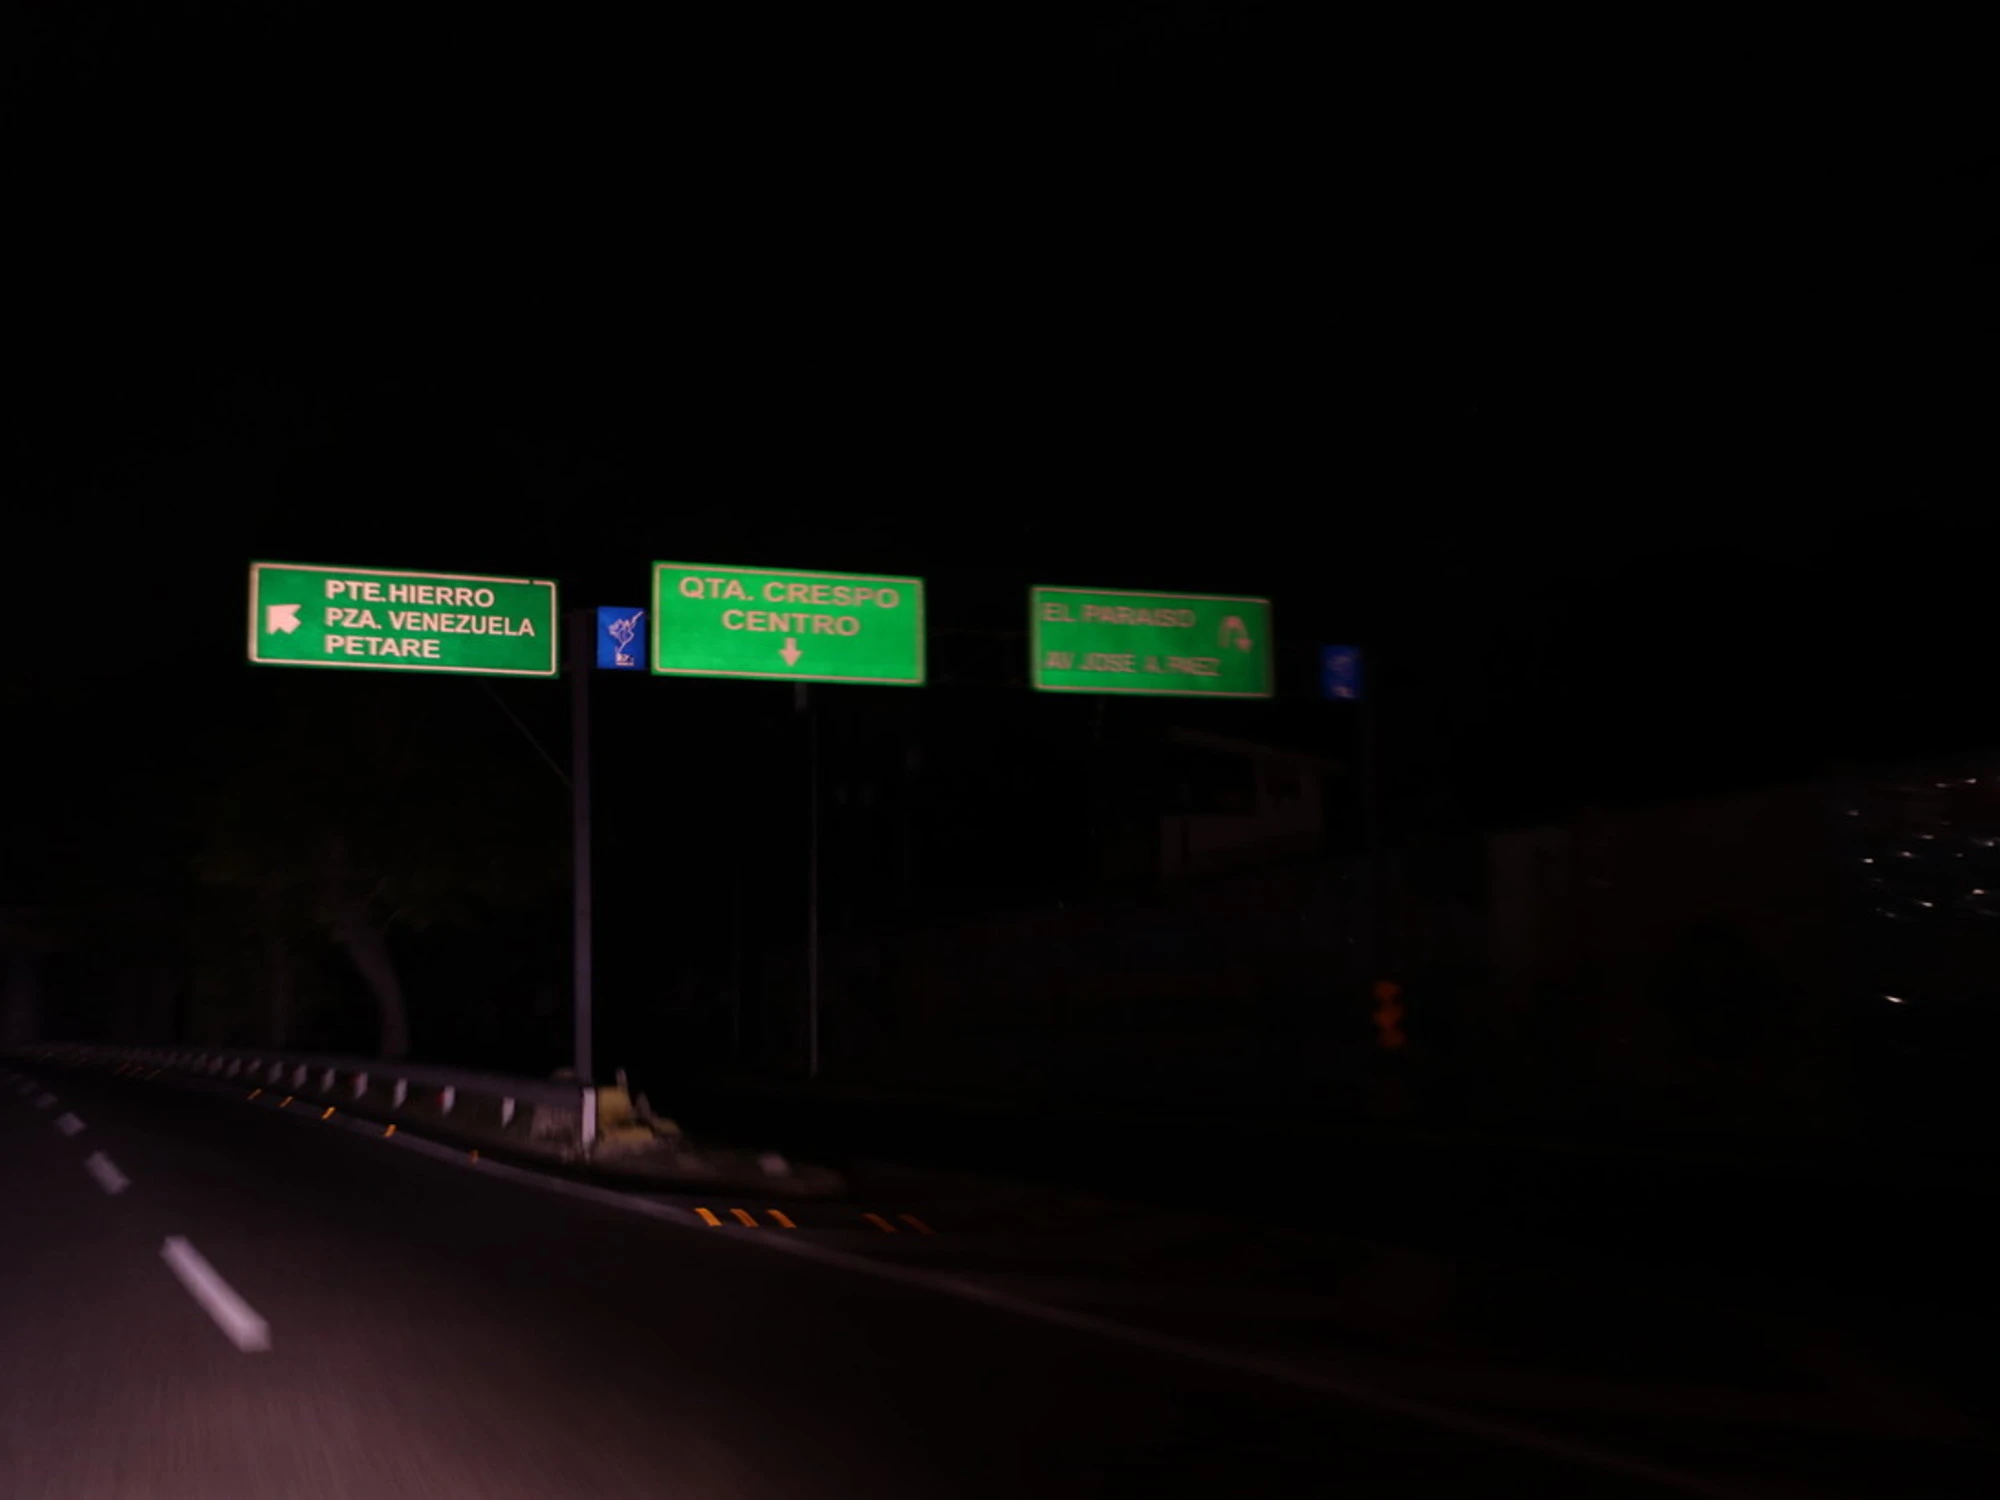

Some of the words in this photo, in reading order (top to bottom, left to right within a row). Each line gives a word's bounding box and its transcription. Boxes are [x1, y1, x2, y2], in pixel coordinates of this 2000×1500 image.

[678, 576, 754, 601] QTA.
[762, 581, 900, 609] CRESPO
[325, 607, 382, 630] PZA.
[388, 610, 535, 637] VENEZUELA
[721, 609, 860, 636] CENTRO
[1043, 602, 1076, 622] EL
[1081, 604, 1196, 628] PARAISO
[325, 634, 441, 659] PETARE
